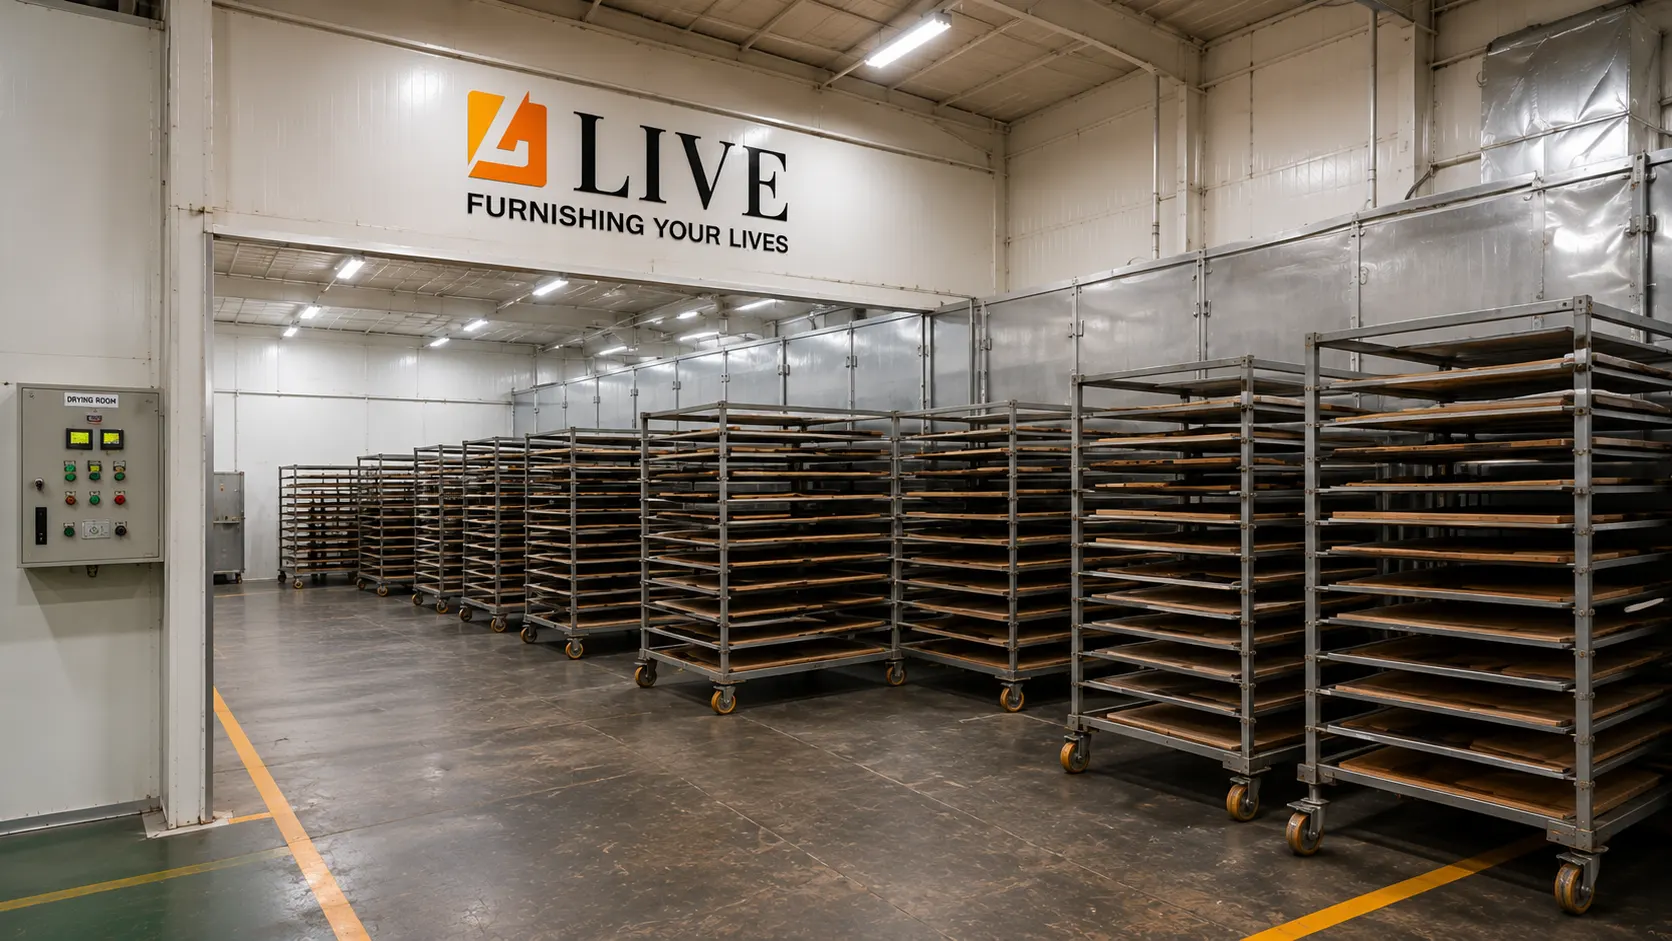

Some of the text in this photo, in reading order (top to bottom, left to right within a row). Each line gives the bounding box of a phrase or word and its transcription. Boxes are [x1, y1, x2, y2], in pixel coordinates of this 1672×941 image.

[573, 111, 789, 222] LIVE
[467, 192, 789, 254] FURNISHING YOUR LIVES
[67, 395, 117, 405] DRYING ROOM
